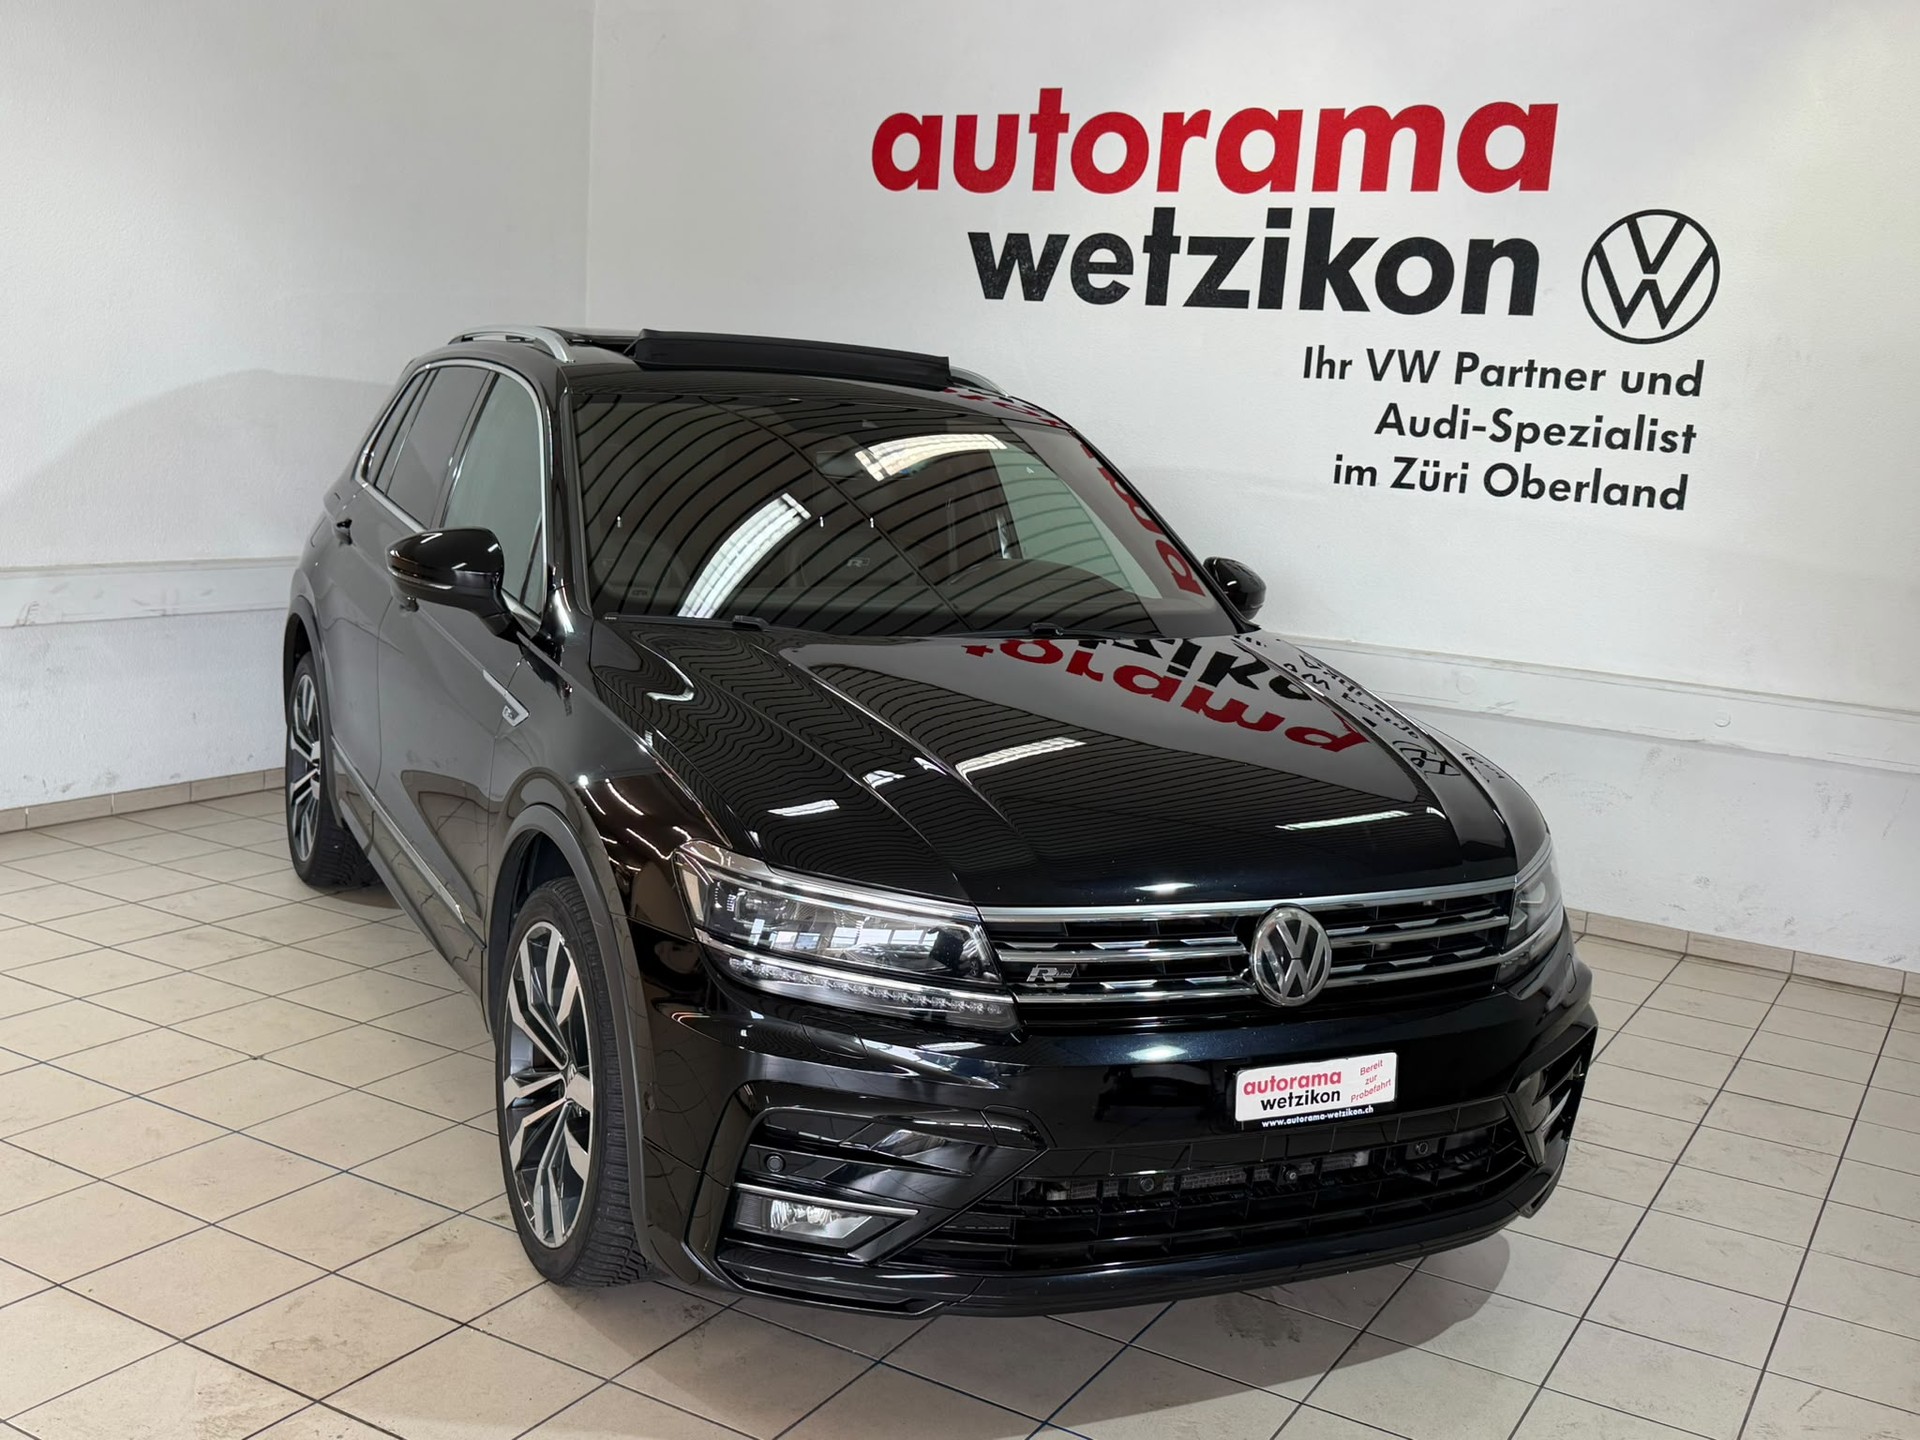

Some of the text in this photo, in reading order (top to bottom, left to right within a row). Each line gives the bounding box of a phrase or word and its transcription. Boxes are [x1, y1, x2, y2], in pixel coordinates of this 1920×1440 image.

[873, 89, 1558, 194] autorama
[968, 207, 1539, 315] wetzikon
[1303, 345, 1704, 397] Ihr VW Partner und
[1375, 403, 1697, 454] Audi-Spezialist
[1334, 455, 1688, 511] im Züri Oberland
[1360, 1059, 1383, 1076] Bereit
[1365, 1073, 1378, 1085] zur
[1243, 1071, 1342, 1095] autorama
[1350, 1079, 1392, 1103] Probefahrt
[1260, 1089, 1341, 1111] wetzikon
[1261, 1105, 1374, 1128] www.autorama-wetzikon.ch
